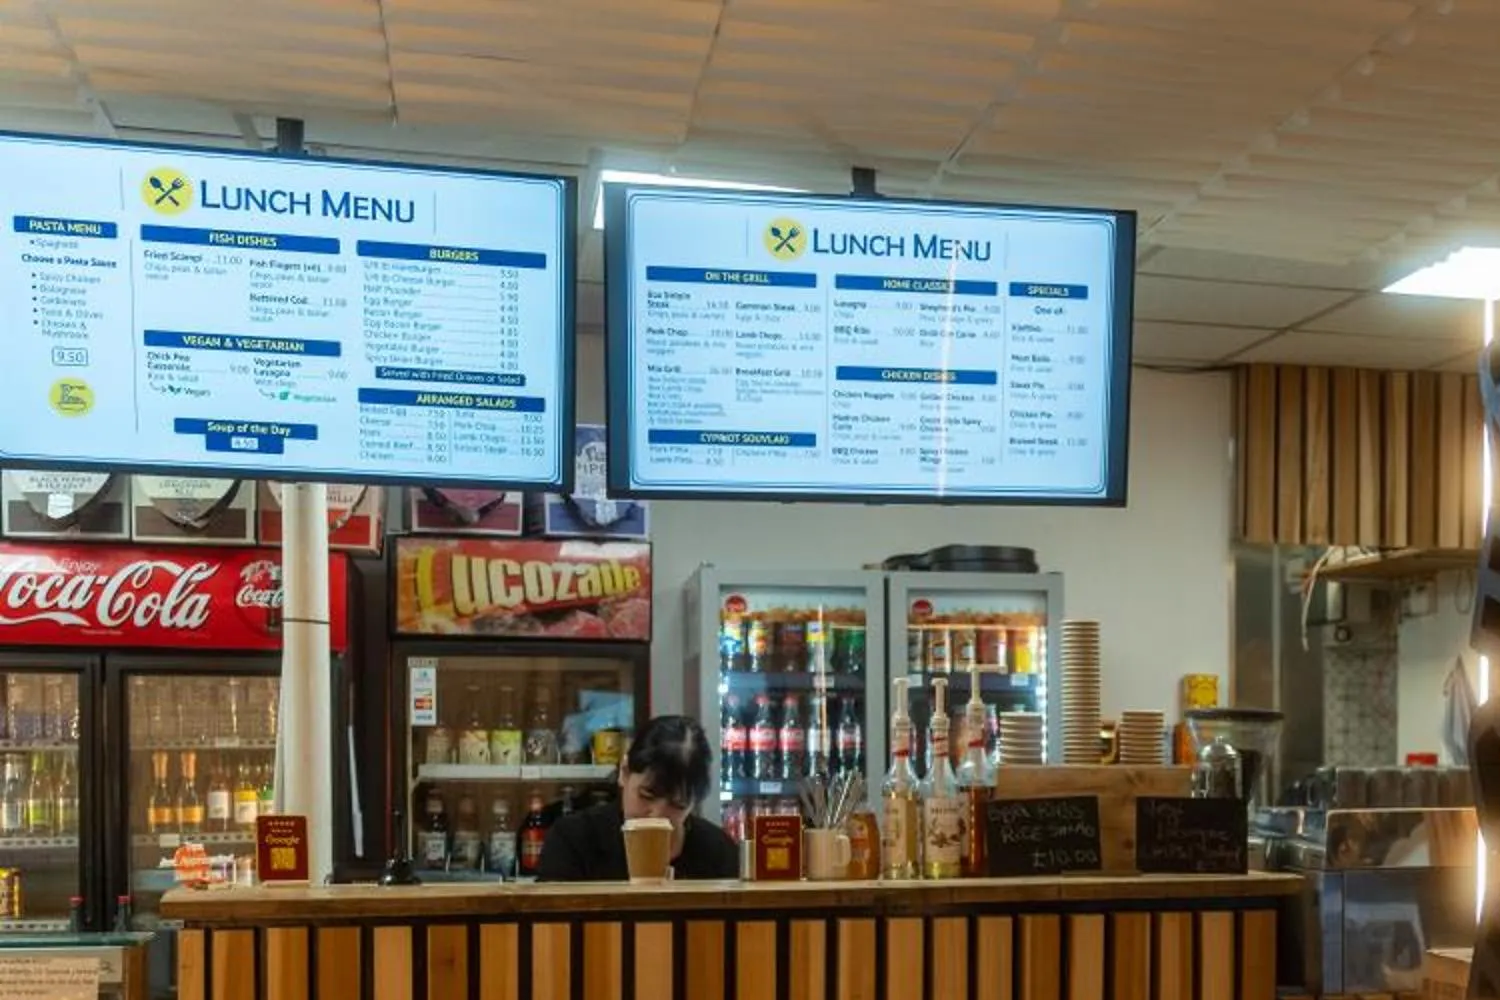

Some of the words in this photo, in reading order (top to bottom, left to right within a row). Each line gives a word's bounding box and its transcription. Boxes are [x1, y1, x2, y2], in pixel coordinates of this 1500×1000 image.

[30, 220, 64, 233] PASTA
[68, 223, 100, 234] MENU
[209, 233, 235, 244] FISH
[237, 235, 277, 247] DISHES
[21, 253, 54, 264] Choose
[64, 256, 89, 266] Pasta
[91, 258, 117, 268] Sauce
[143, 250, 168, 260] Fried
[429, 249, 479, 262] BURGERS
[705, 271, 721, 281] ON
[723, 272, 741, 282] THE
[743, 273, 769, 283] GRILL
[883, 279, 910, 289] HOME
[182, 335, 221, 347] VEGAN
[225, 337, 233, 347] &
[236, 339, 305, 352] VEGETARIAN
[416, 393, 473, 406] ARRANGED
[476, 397, 516, 409] SALADS
[208, 422, 235, 434] Soup
[237, 423, 249, 433] of
[250, 424, 269, 435] the
[271, 425, 291, 437] Day
